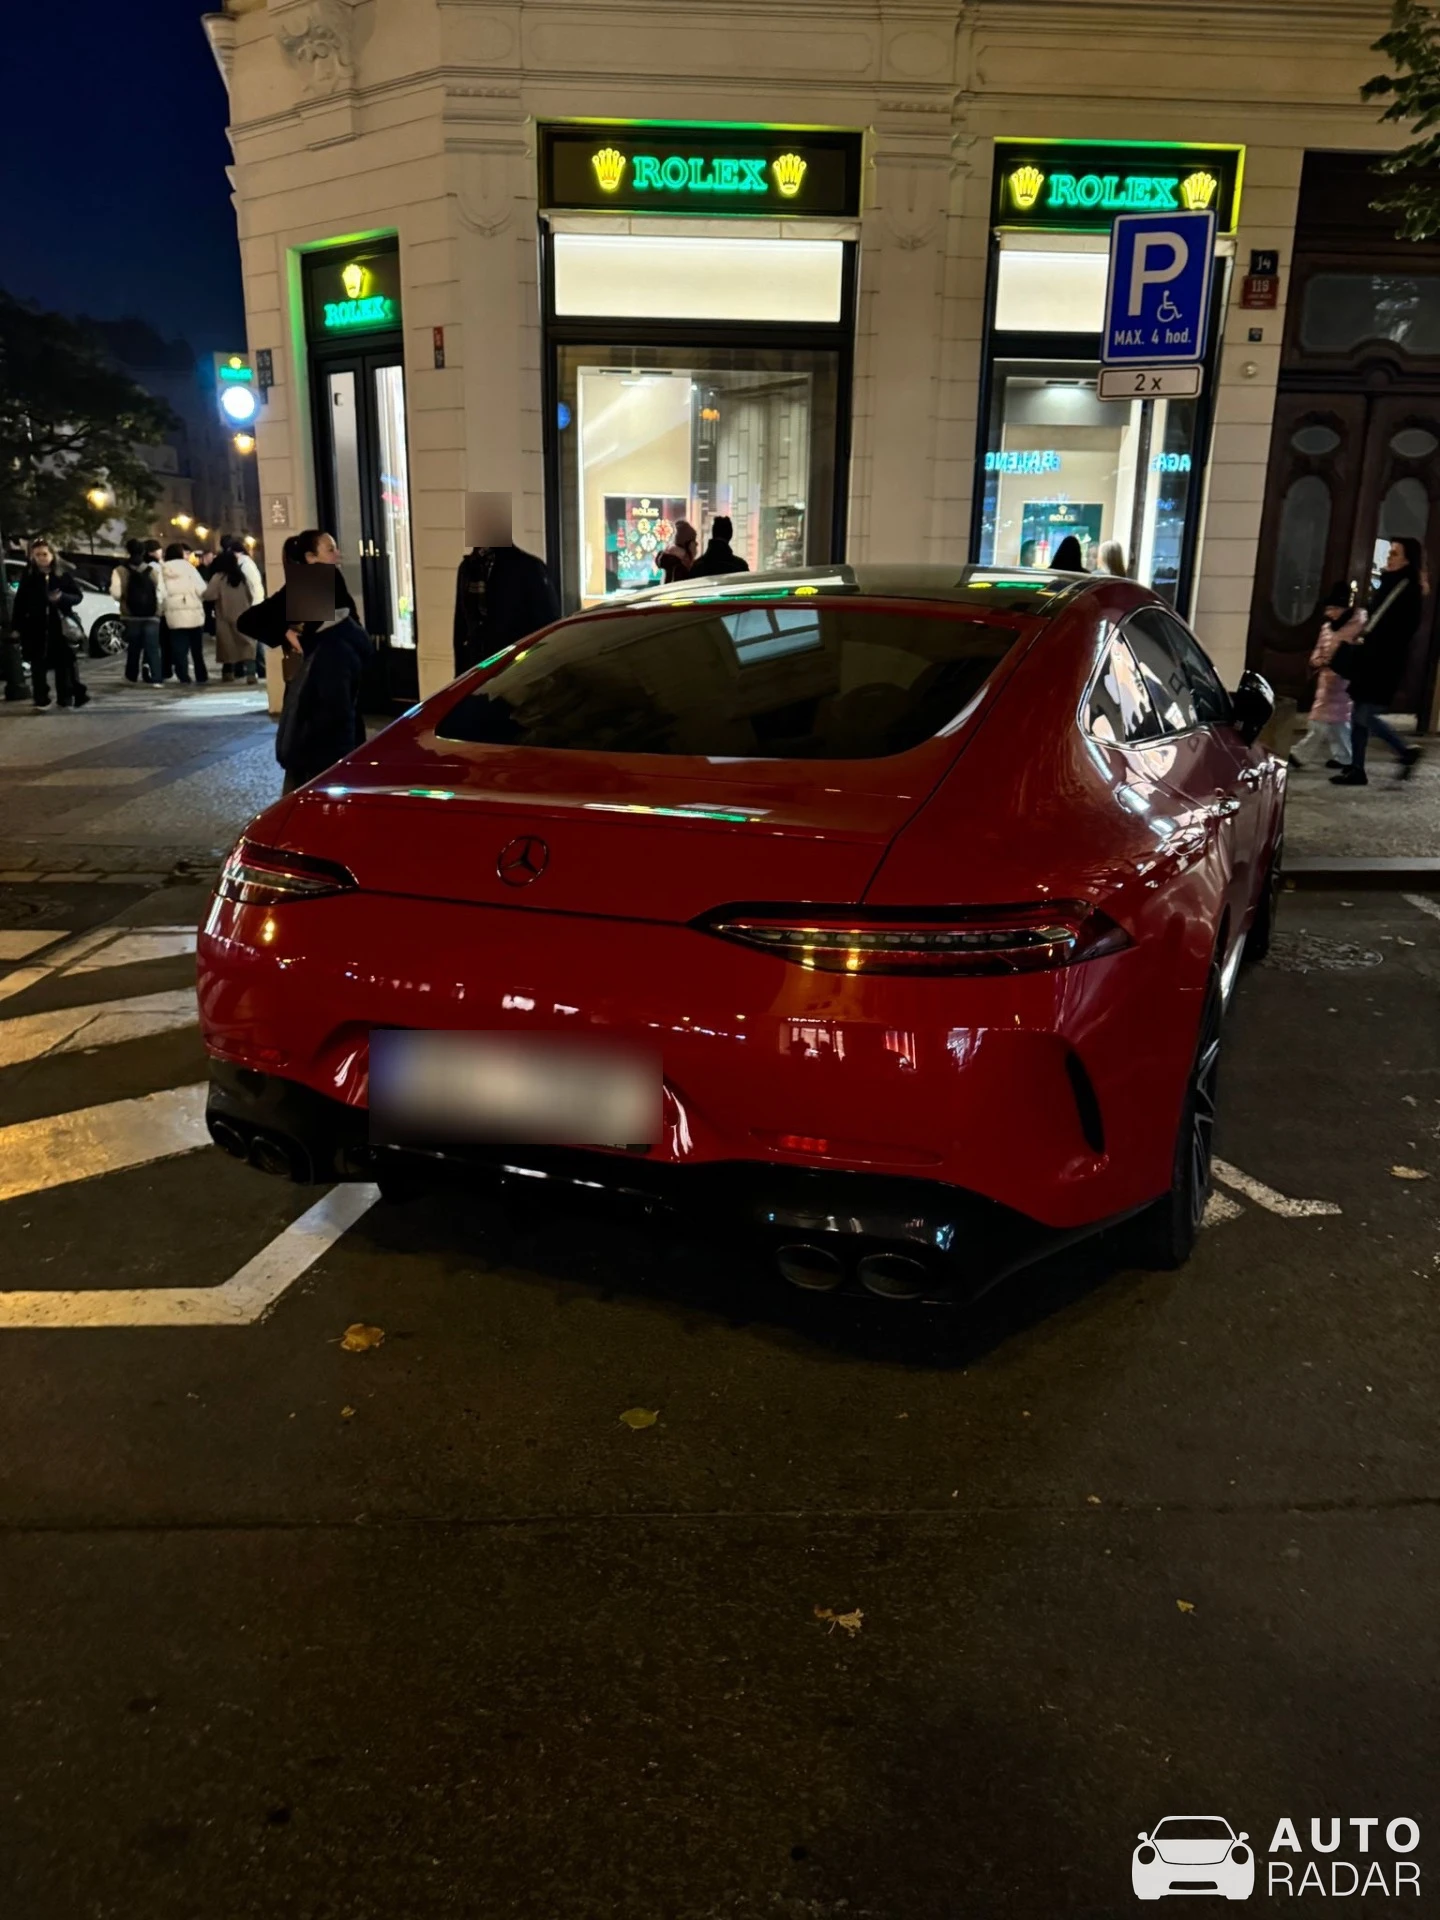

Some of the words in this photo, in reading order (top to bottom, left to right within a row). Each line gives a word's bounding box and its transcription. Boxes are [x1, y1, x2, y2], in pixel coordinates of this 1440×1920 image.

[632, 156, 768, 191] ROLEX
[1047, 173, 1179, 208] ROLEX
[1127, 231, 1189, 317] P
[1256, 255, 1272, 271] 14
[324, 296, 386, 327] ROLEX
[1114, 330, 1144, 346] MAX.
[1151, 329, 1160, 344] 4
[1165, 328, 1192, 344] hod.
[1134, 374, 1145, 391] 2
[1151, 377, 1163, 390] x
